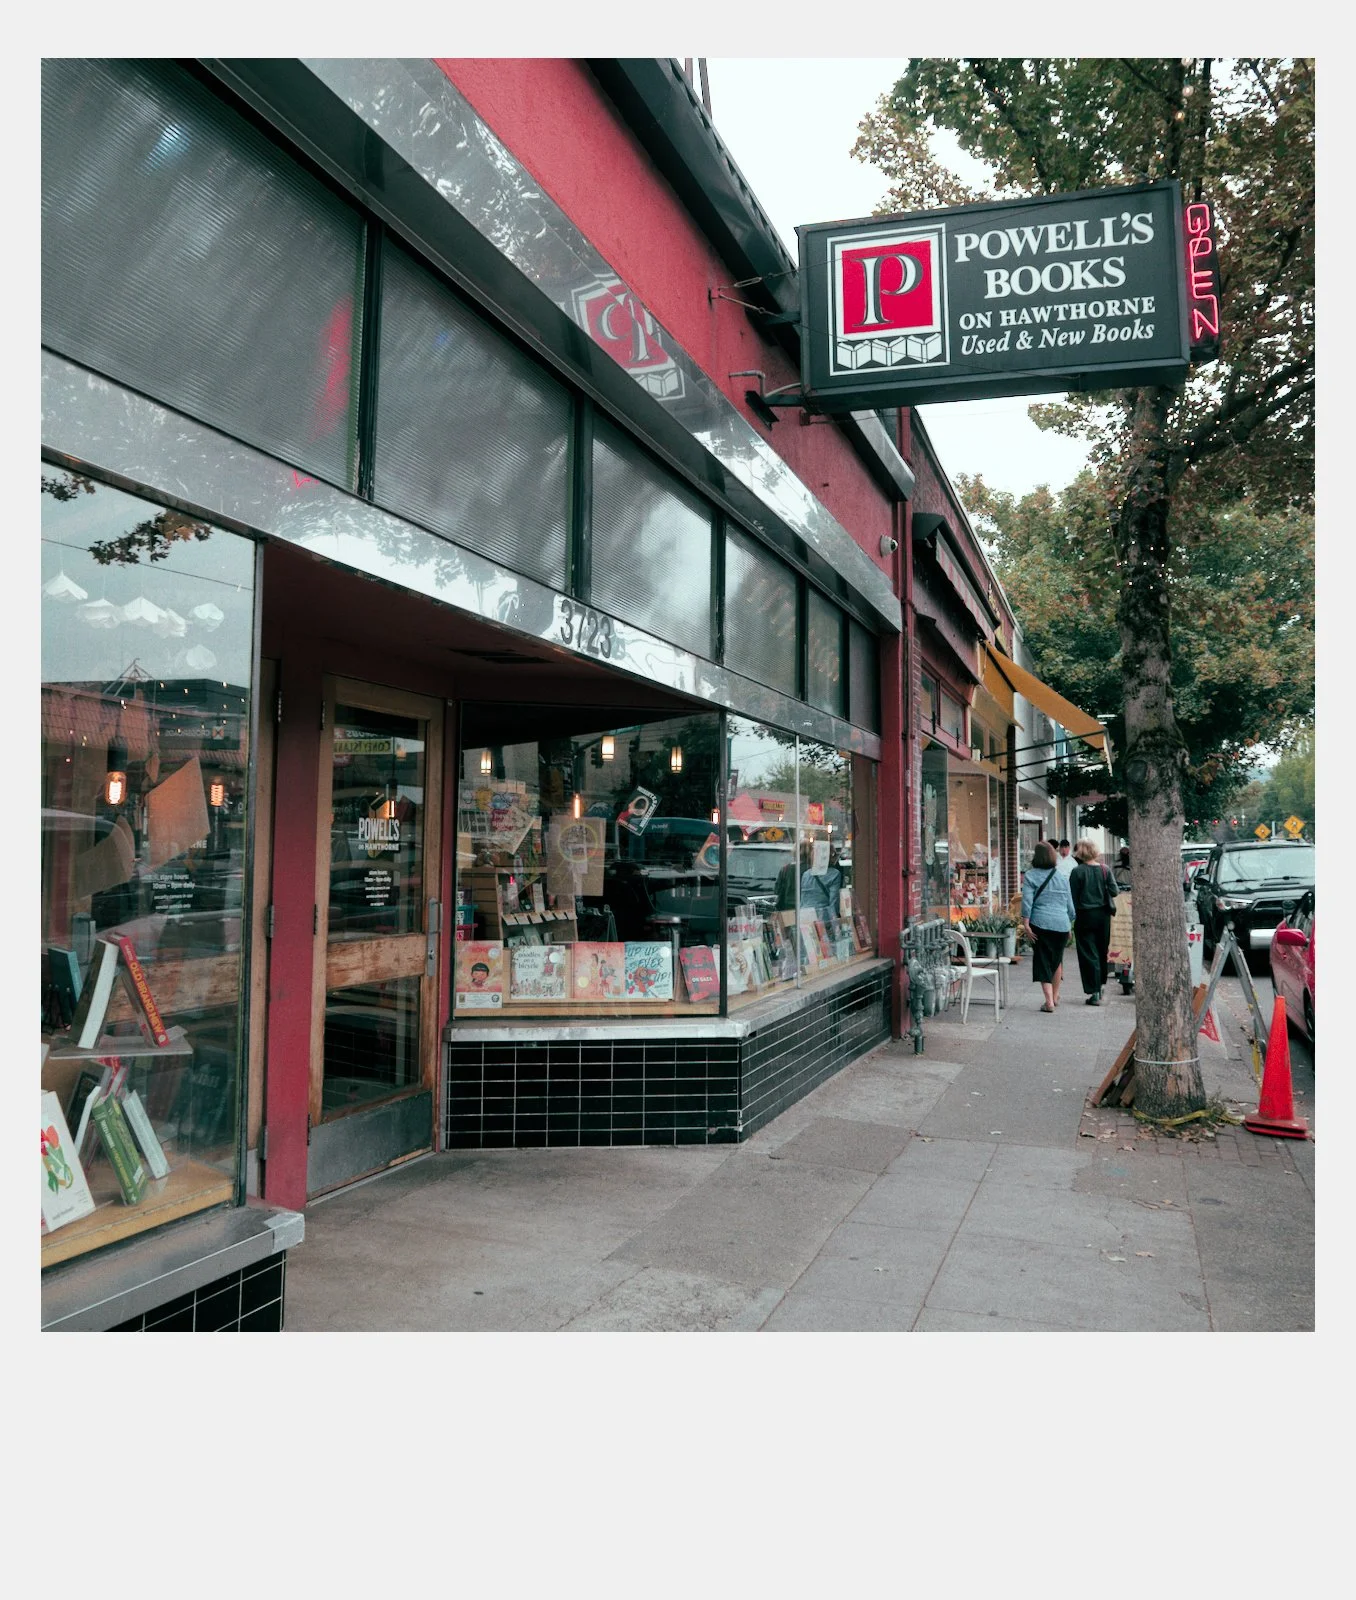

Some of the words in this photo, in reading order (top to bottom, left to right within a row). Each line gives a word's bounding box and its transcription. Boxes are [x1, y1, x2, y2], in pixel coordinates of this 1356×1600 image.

[953, 211, 1155, 263] POWELL'S
[852, 253, 924, 328] P
[983, 255, 1127, 299] BOOKS
[1185, 202, 1220, 340] OPEN
[959, 311, 992, 330] ON
[999, 296, 1156, 327] HAWTHORNE
[961, 330, 1010, 356] Used
[1015, 330, 1034, 350] &
[1038, 326, 1086, 349] New
[1090, 318, 1155, 344] Books
[560, 598, 612, 659] 3723
[358, 817, 400, 841] POWELL'S
[364, 843, 400, 851] HAWTHORNE
[639, 956, 664, 968] EVER
[129, 961, 143, 981] OLD
[137, 980, 156, 1014] BRAND
[148, 1013, 164, 1034] NEW
